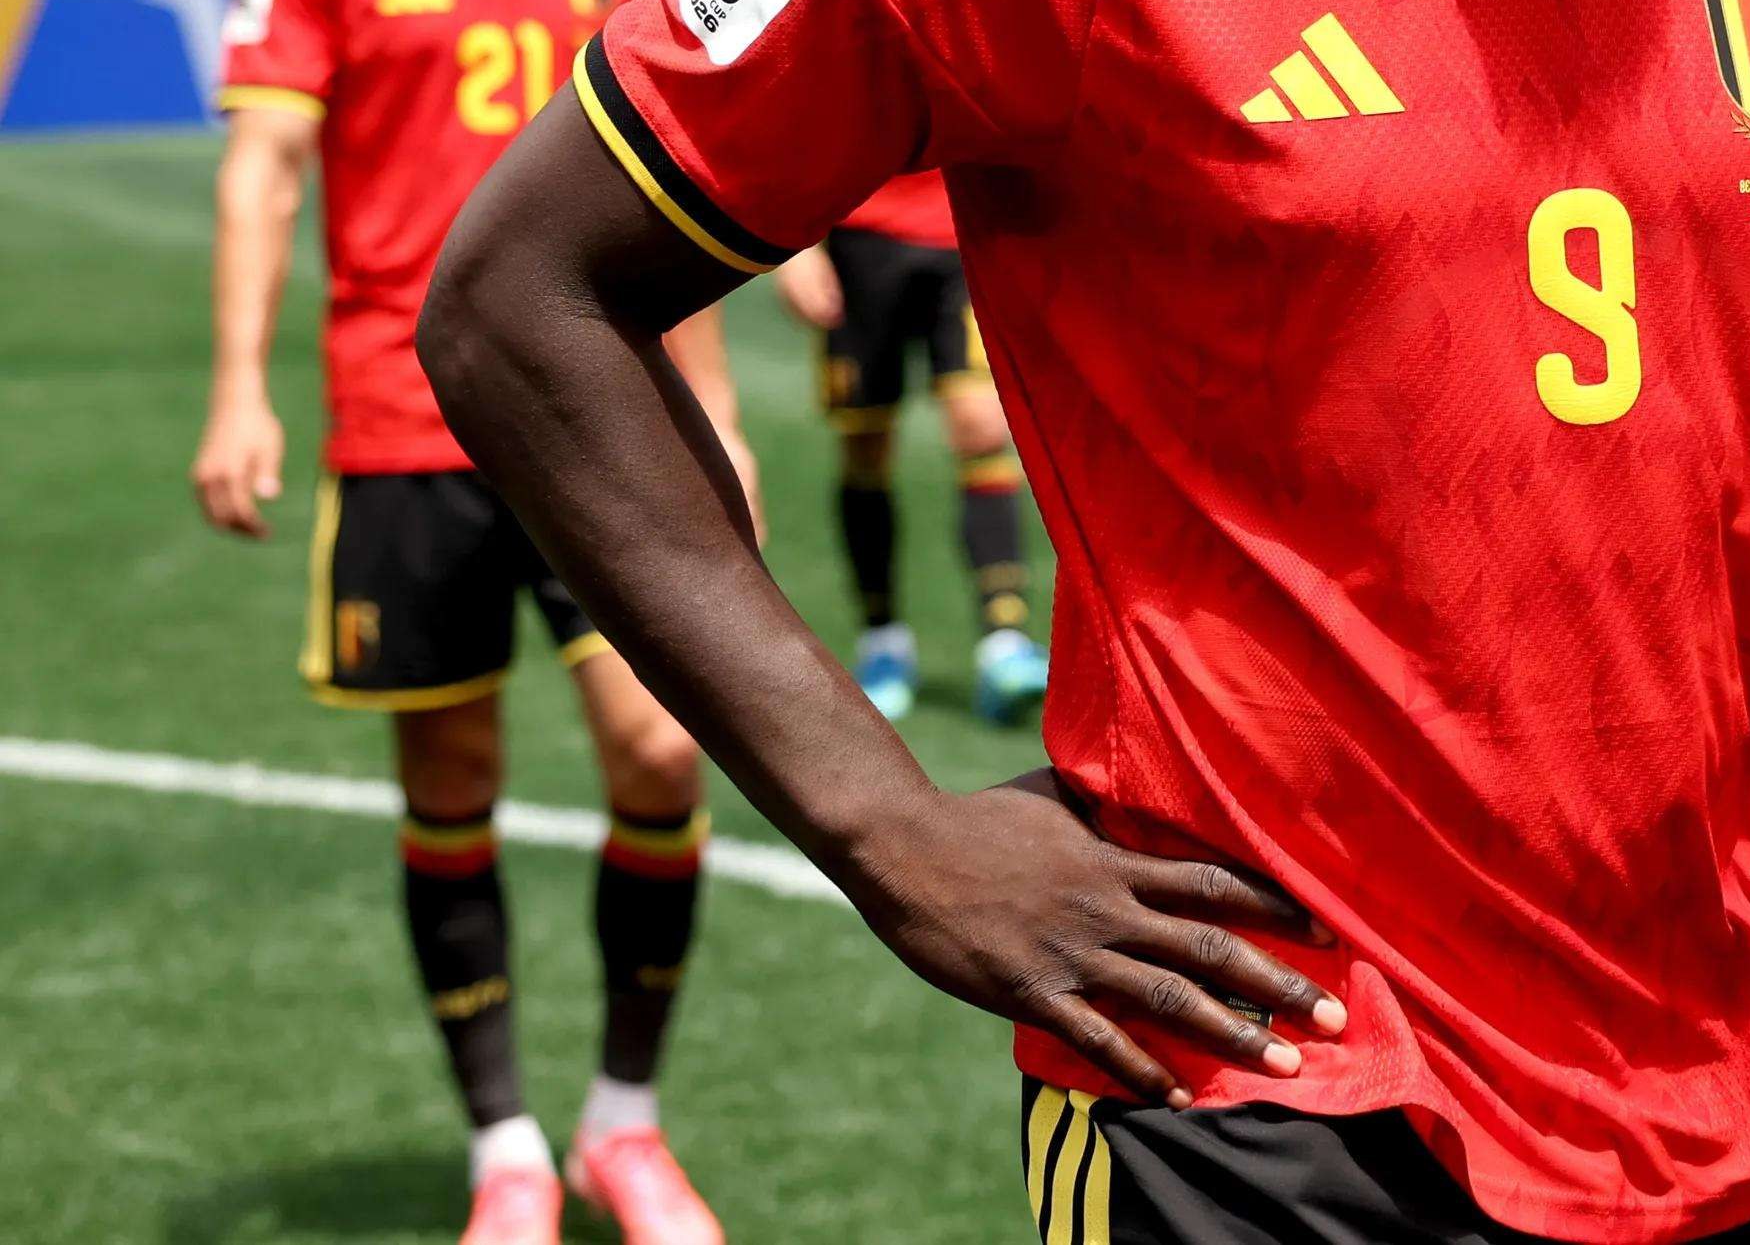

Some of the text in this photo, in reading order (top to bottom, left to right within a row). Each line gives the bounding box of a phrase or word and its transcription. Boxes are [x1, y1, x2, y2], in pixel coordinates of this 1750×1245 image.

[709, 0, 727, 19] CUP
[455, 19, 554, 135] 21
[1527, 187, 1642, 425] 9
